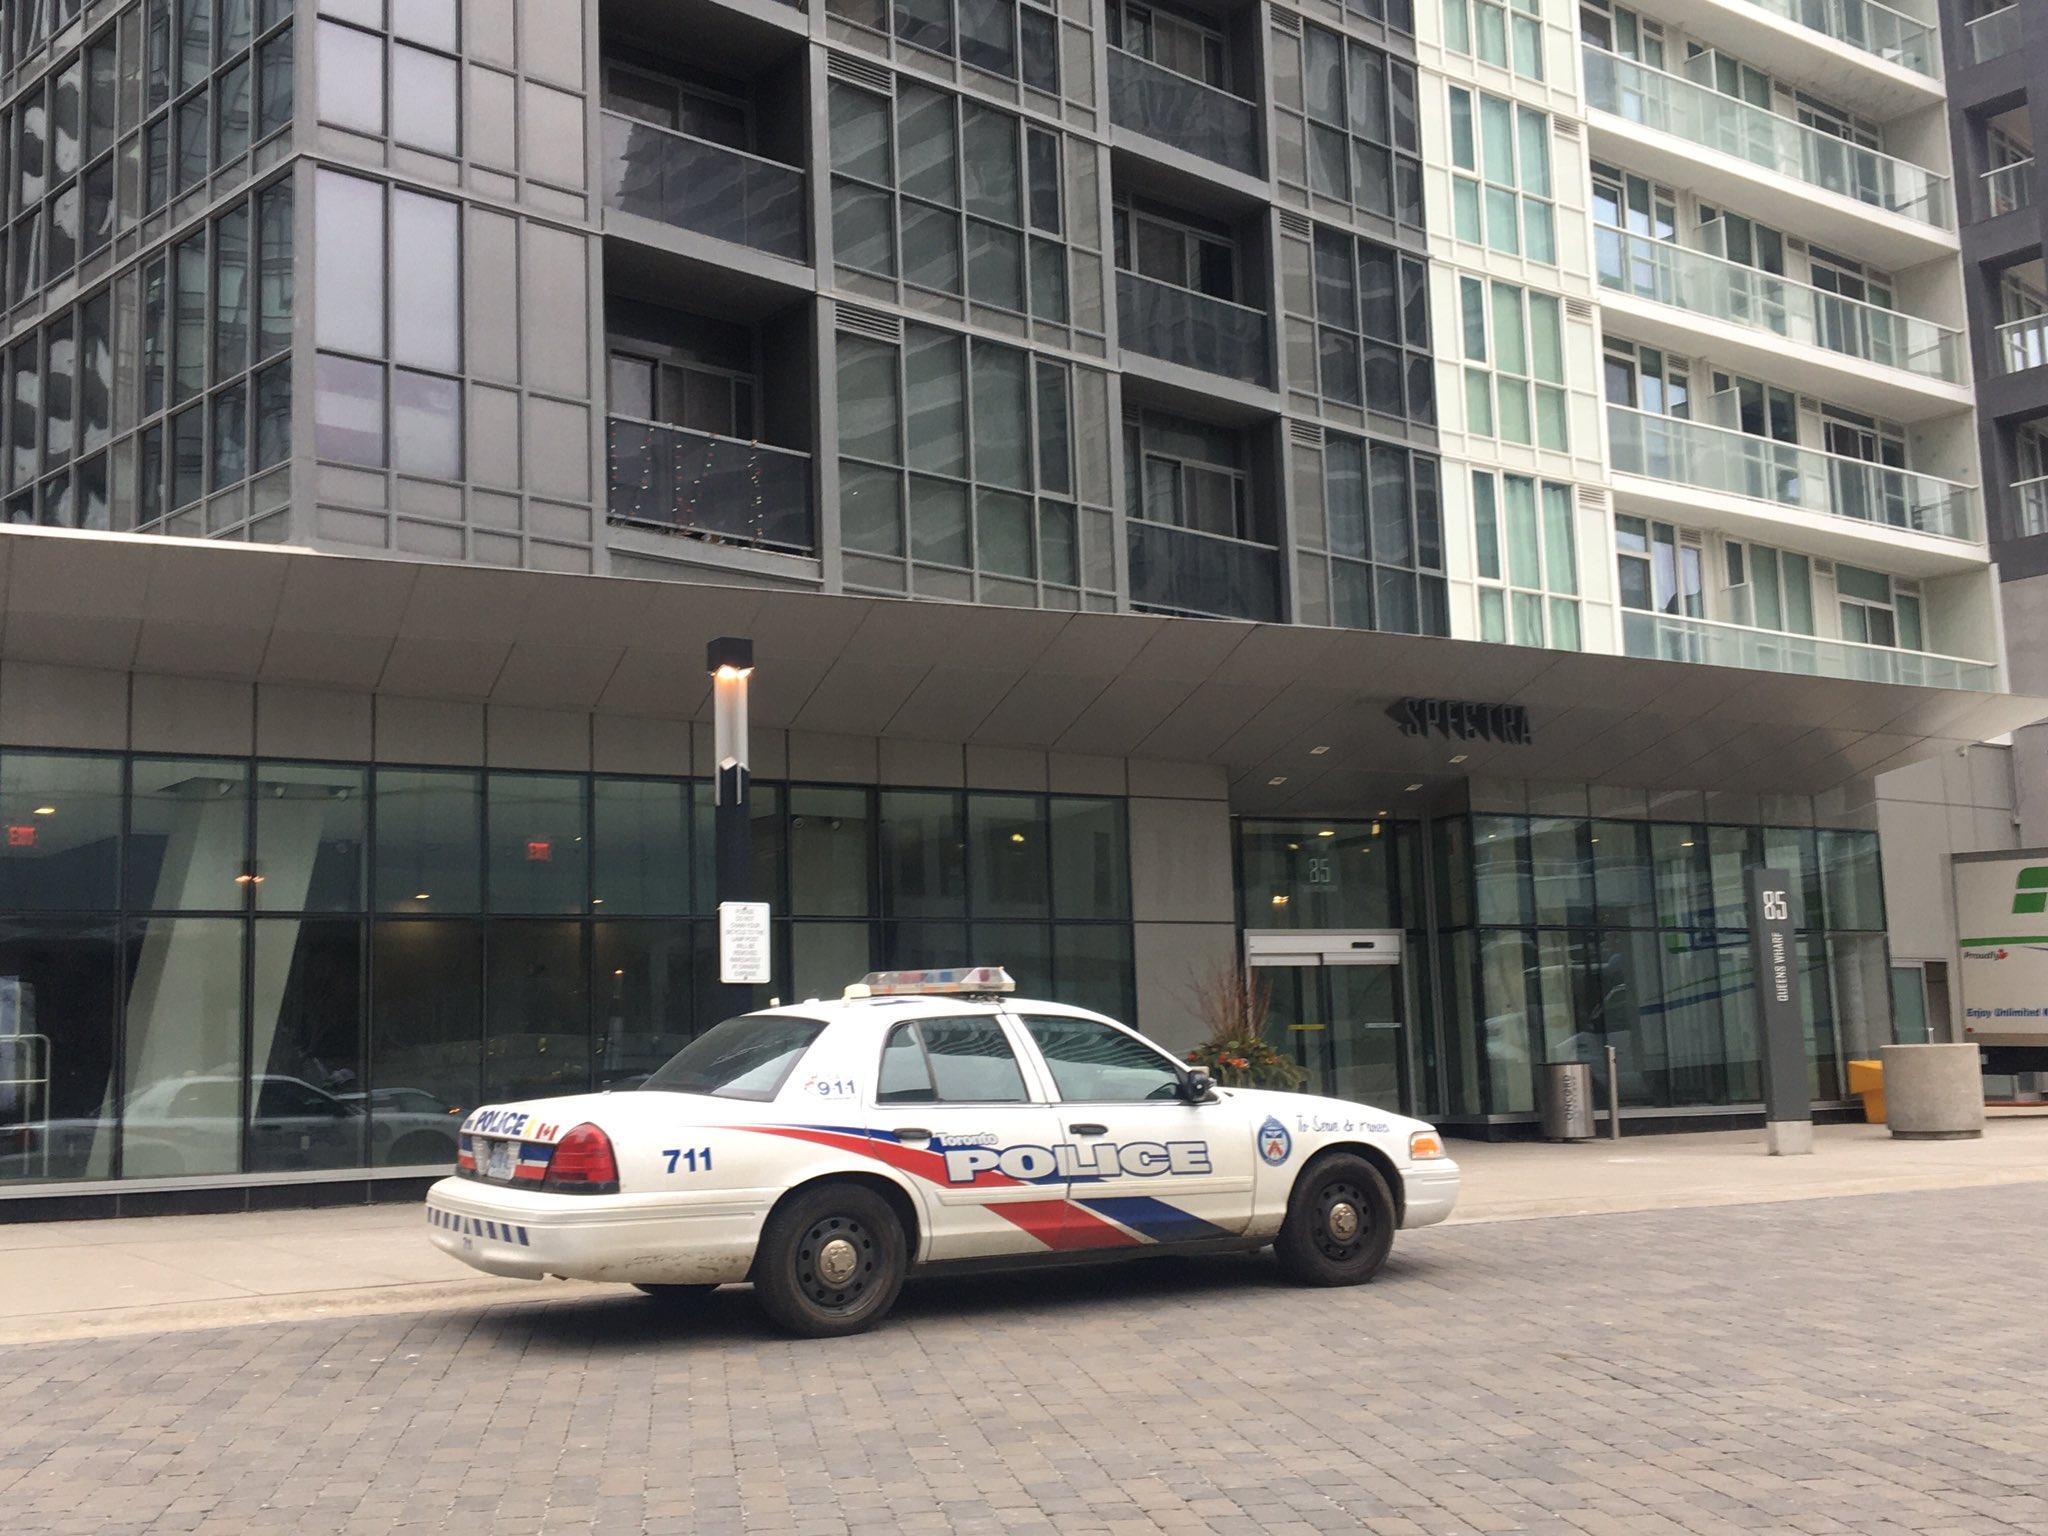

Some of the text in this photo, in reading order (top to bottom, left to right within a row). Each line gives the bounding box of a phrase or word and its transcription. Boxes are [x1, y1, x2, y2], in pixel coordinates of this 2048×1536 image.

[1309, 858, 1330, 883] 85
[1763, 890, 1788, 920] 85
[1771, 932, 1789, 1002] QUEENS WHARF
[473, 1110, 530, 1136] POLICE
[937, 1131, 999, 1147] Toronto
[661, 1146, 712, 1174] 711
[944, 1140, 1213, 1183] POLICE
